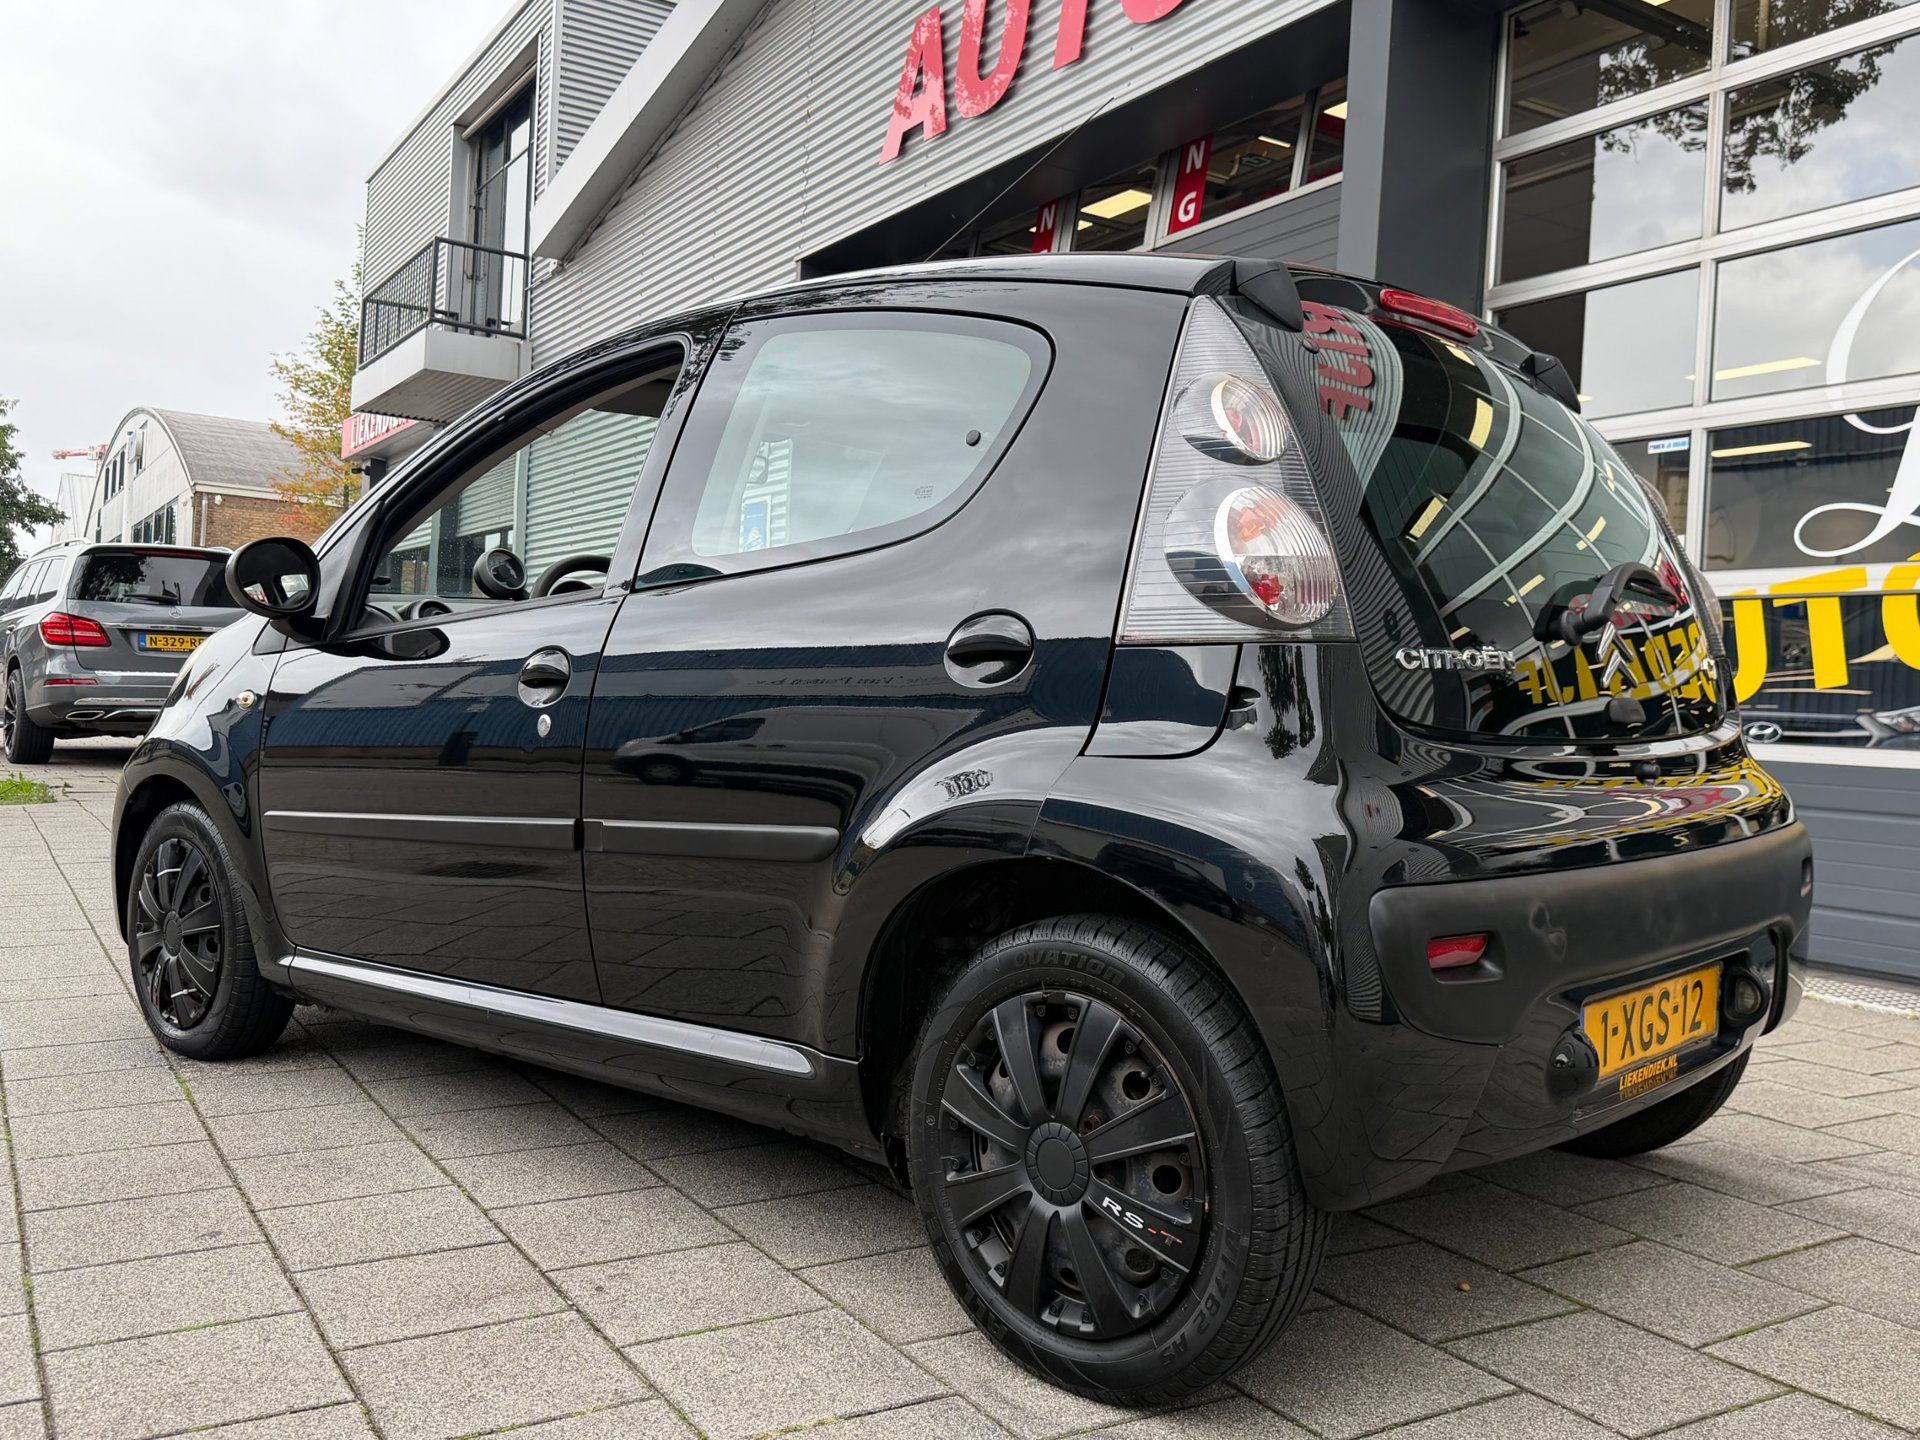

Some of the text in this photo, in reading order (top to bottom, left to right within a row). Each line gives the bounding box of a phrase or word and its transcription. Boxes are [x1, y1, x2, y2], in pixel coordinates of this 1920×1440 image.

[1396, 645, 1516, 671] CITROËN
[1601, 979, 1704, 1068] 1-XGS-12
[1619, 1054, 1679, 1090] LIEKENDIEK.NL
[1102, 1196, 1183, 1247] RS-T
